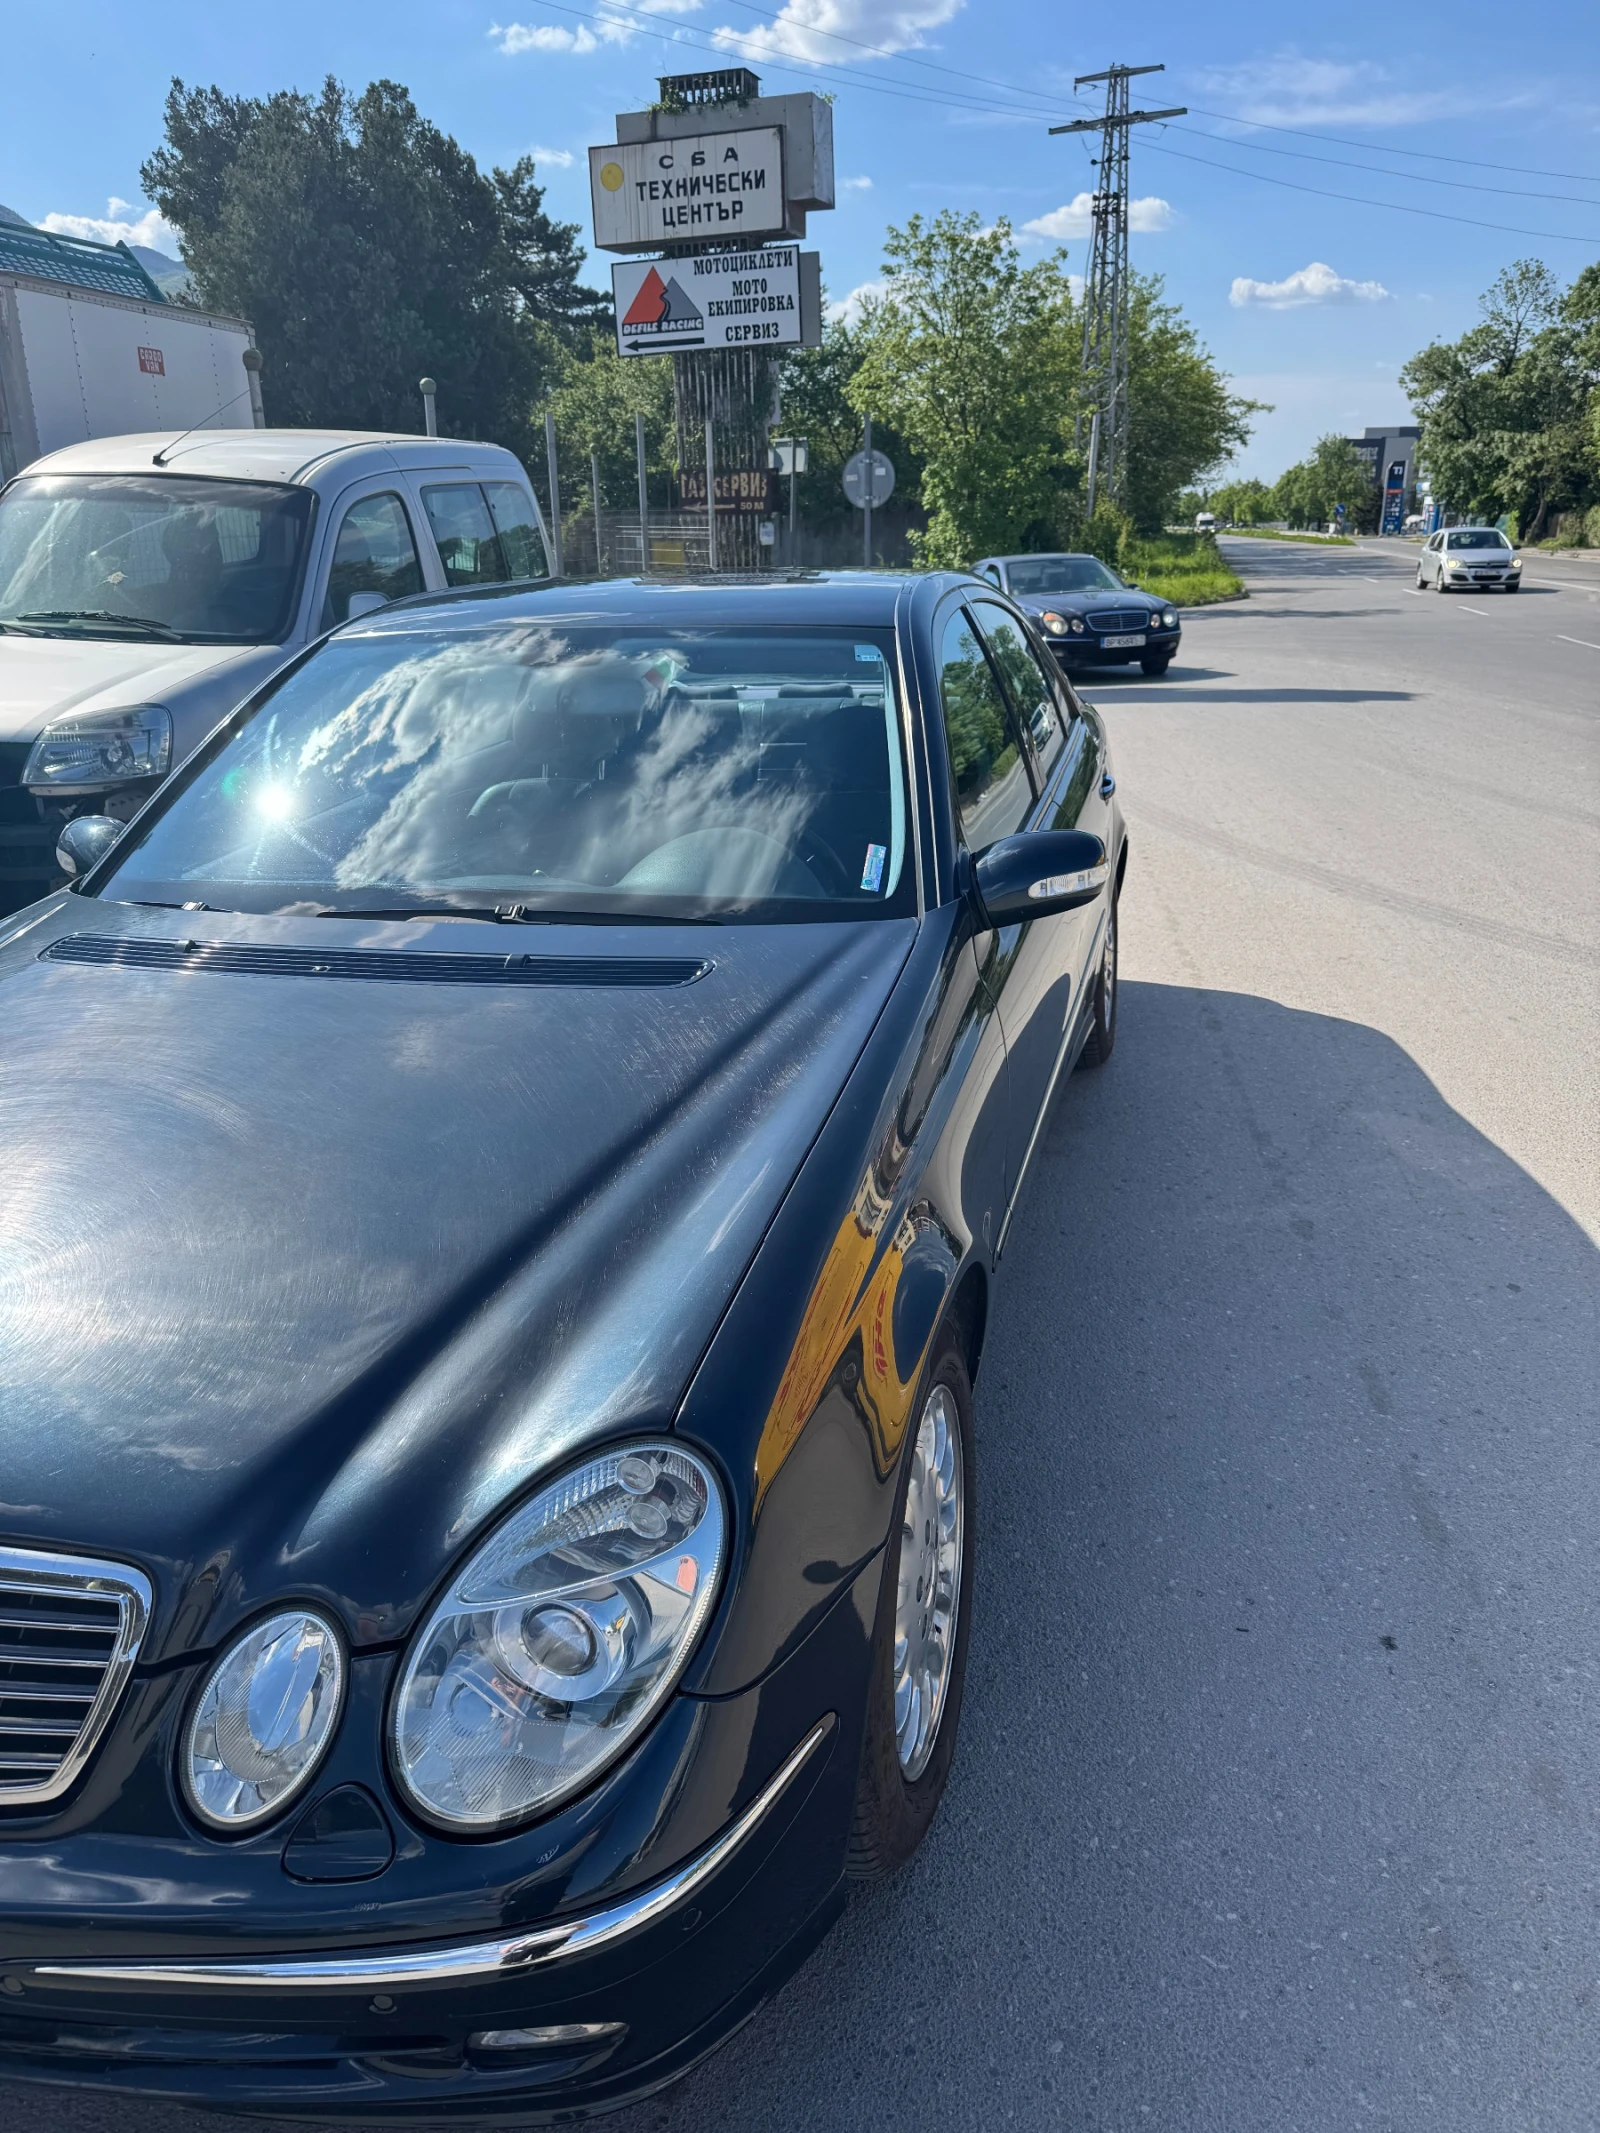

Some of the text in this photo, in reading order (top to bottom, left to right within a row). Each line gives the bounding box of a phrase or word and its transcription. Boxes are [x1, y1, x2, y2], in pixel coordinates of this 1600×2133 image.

[636, 168, 766, 202] ТЕХНИЧЕСКИ
[662, 200, 744, 228] ЦЕНТЪР
[693, 250, 793, 276] МОТОЦИКЛЕТИ
[732, 278, 768, 297] МОТО
[707, 294, 795, 317] ЕКИПИРОВКА
[623, 318, 703, 335] DEFILE RACING
[725, 322, 780, 342] СЕРВИЗ
[713, 472, 767, 498] СЕРВИЗ
[740, 501, 752, 510] 50
